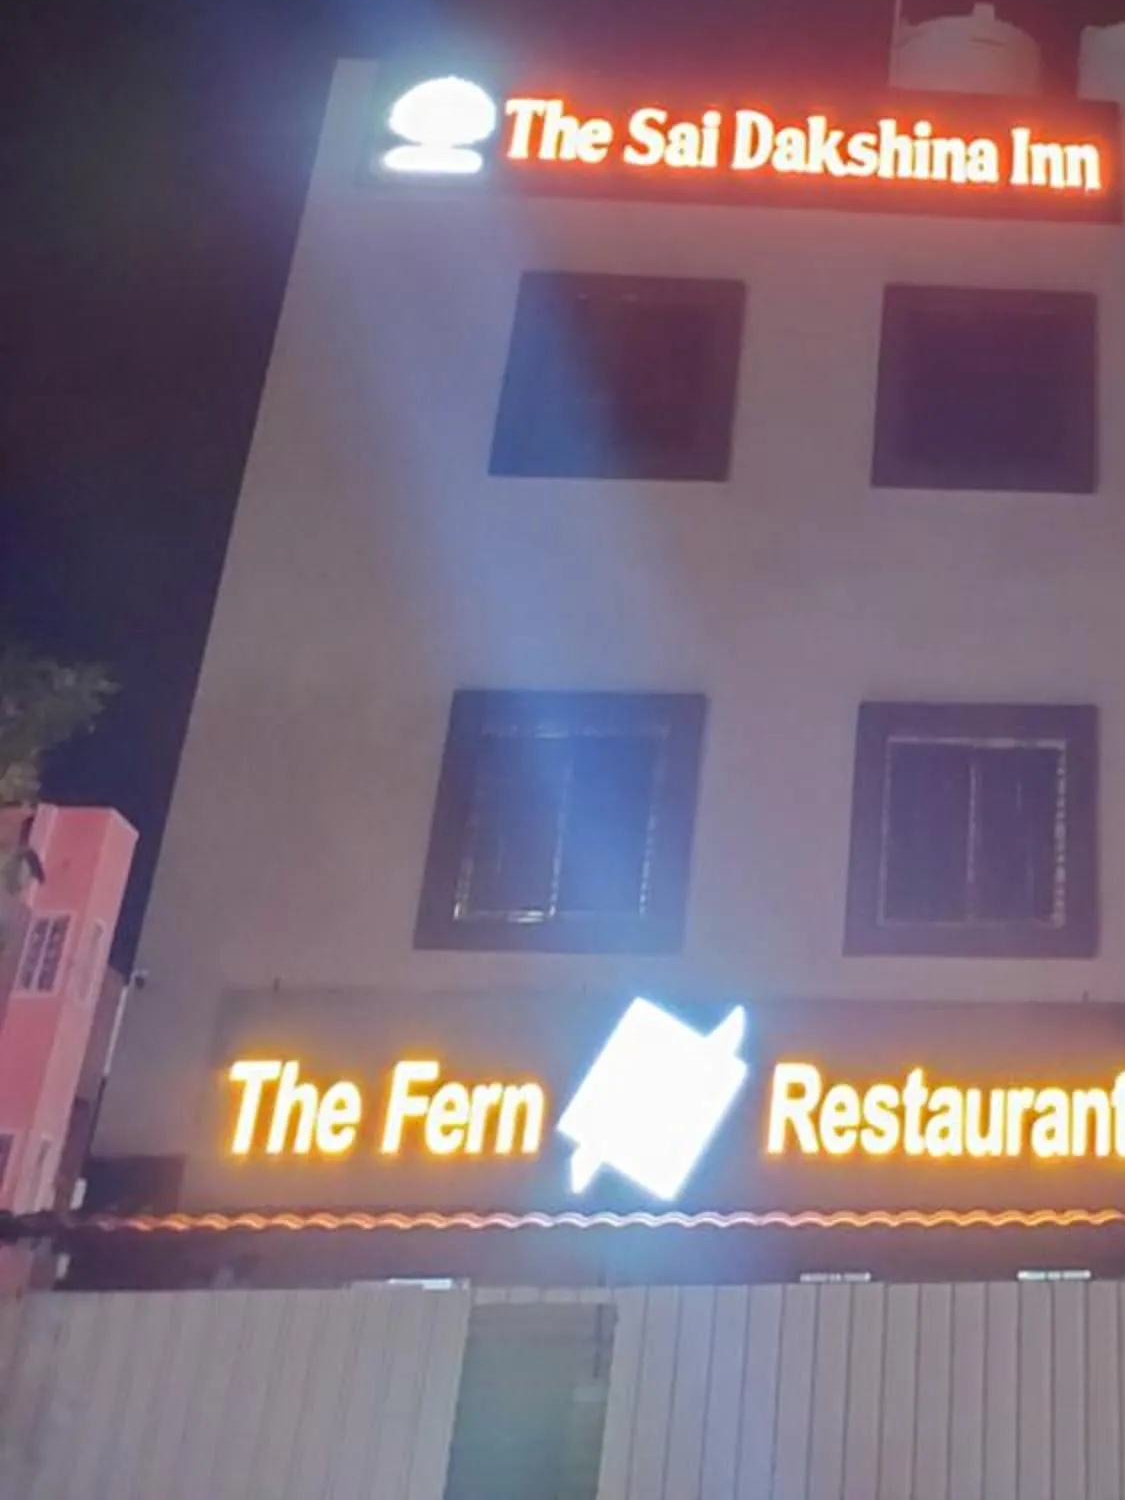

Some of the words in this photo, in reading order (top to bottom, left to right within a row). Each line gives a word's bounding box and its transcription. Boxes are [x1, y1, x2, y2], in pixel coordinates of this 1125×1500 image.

[504, 97, 611, 163] The
[622, 108, 721, 169] Sai
[730, 110, 1000, 184] Dakshina
[1008, 127, 1102, 191] Inn
[228, 1060, 358, 1154] The
[379, 1060, 546, 1156] Fern
